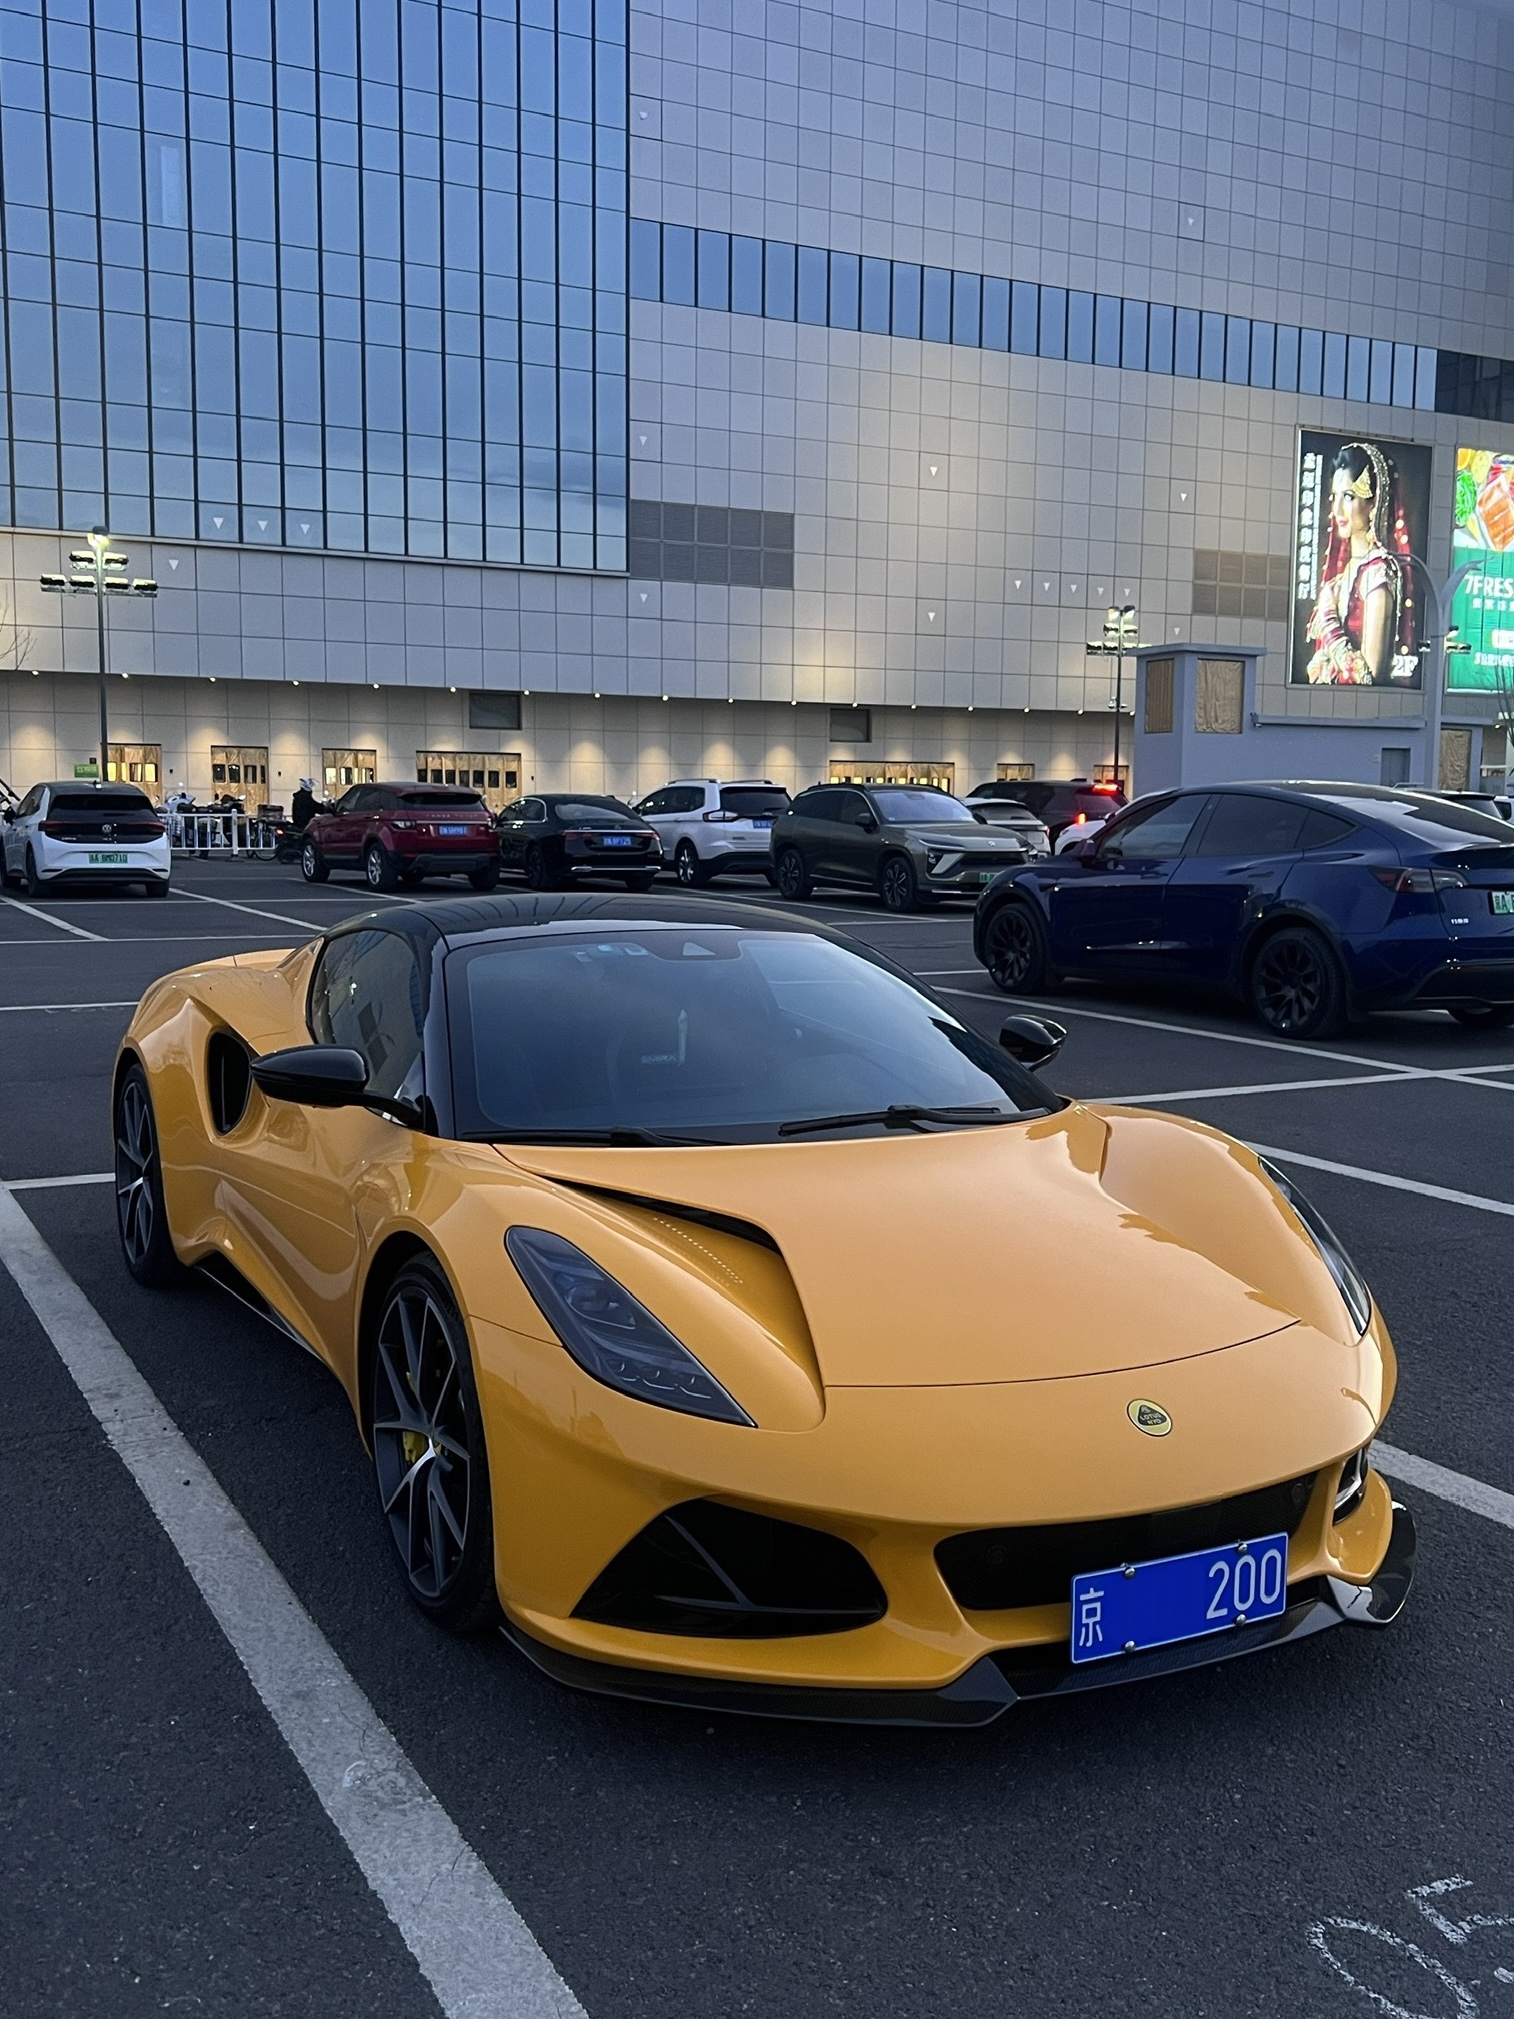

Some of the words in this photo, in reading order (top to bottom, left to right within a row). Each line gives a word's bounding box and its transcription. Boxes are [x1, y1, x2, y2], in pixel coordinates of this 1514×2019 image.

[1391, 655, 1418, 677] 2F
[1140, 1412, 1162, 1421] LOTUS
[1079, 1587, 1105, 1648] 京
[1206, 1548, 1282, 1620] 200
